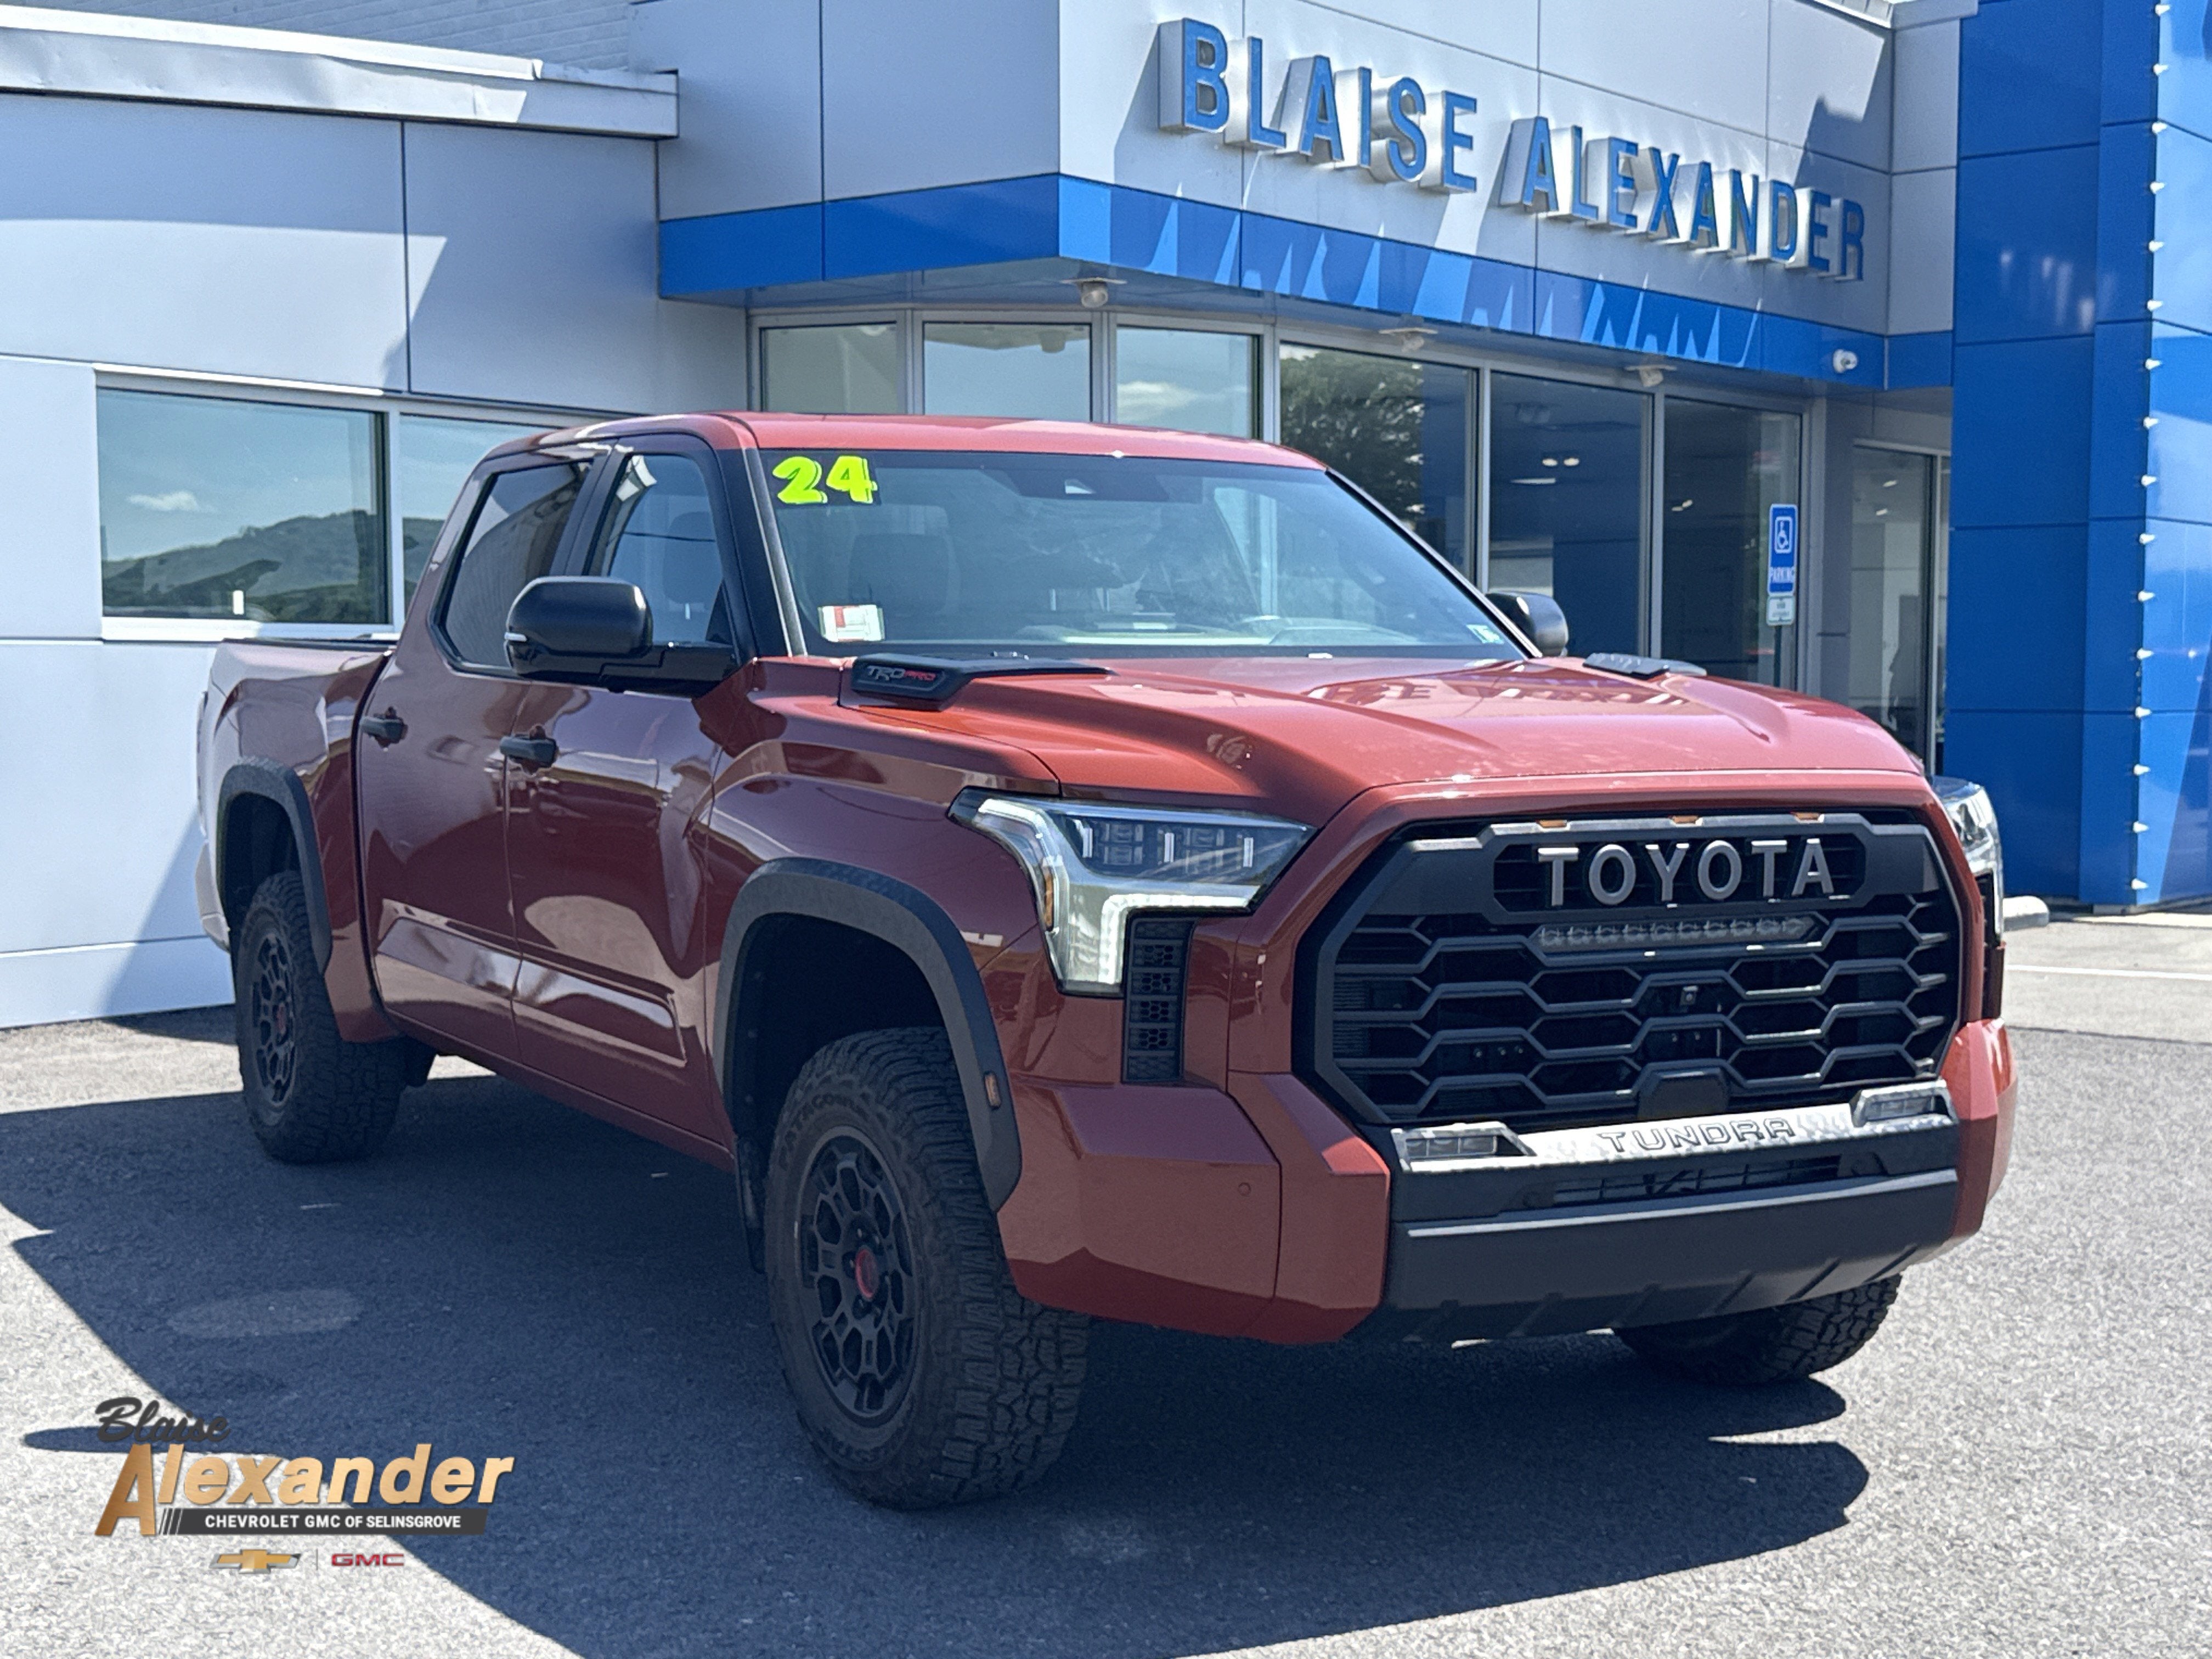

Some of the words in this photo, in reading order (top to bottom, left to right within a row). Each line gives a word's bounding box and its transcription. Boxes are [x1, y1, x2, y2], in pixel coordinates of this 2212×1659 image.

[1180, 16, 1477, 193] BLAISE
[1521, 116, 1865, 281] ALEXANDER
[772, 455, 878, 504] 24
[1538, 838, 1834, 906] TOYOTA
[1597, 1118, 1796, 1153] TUNDRA
